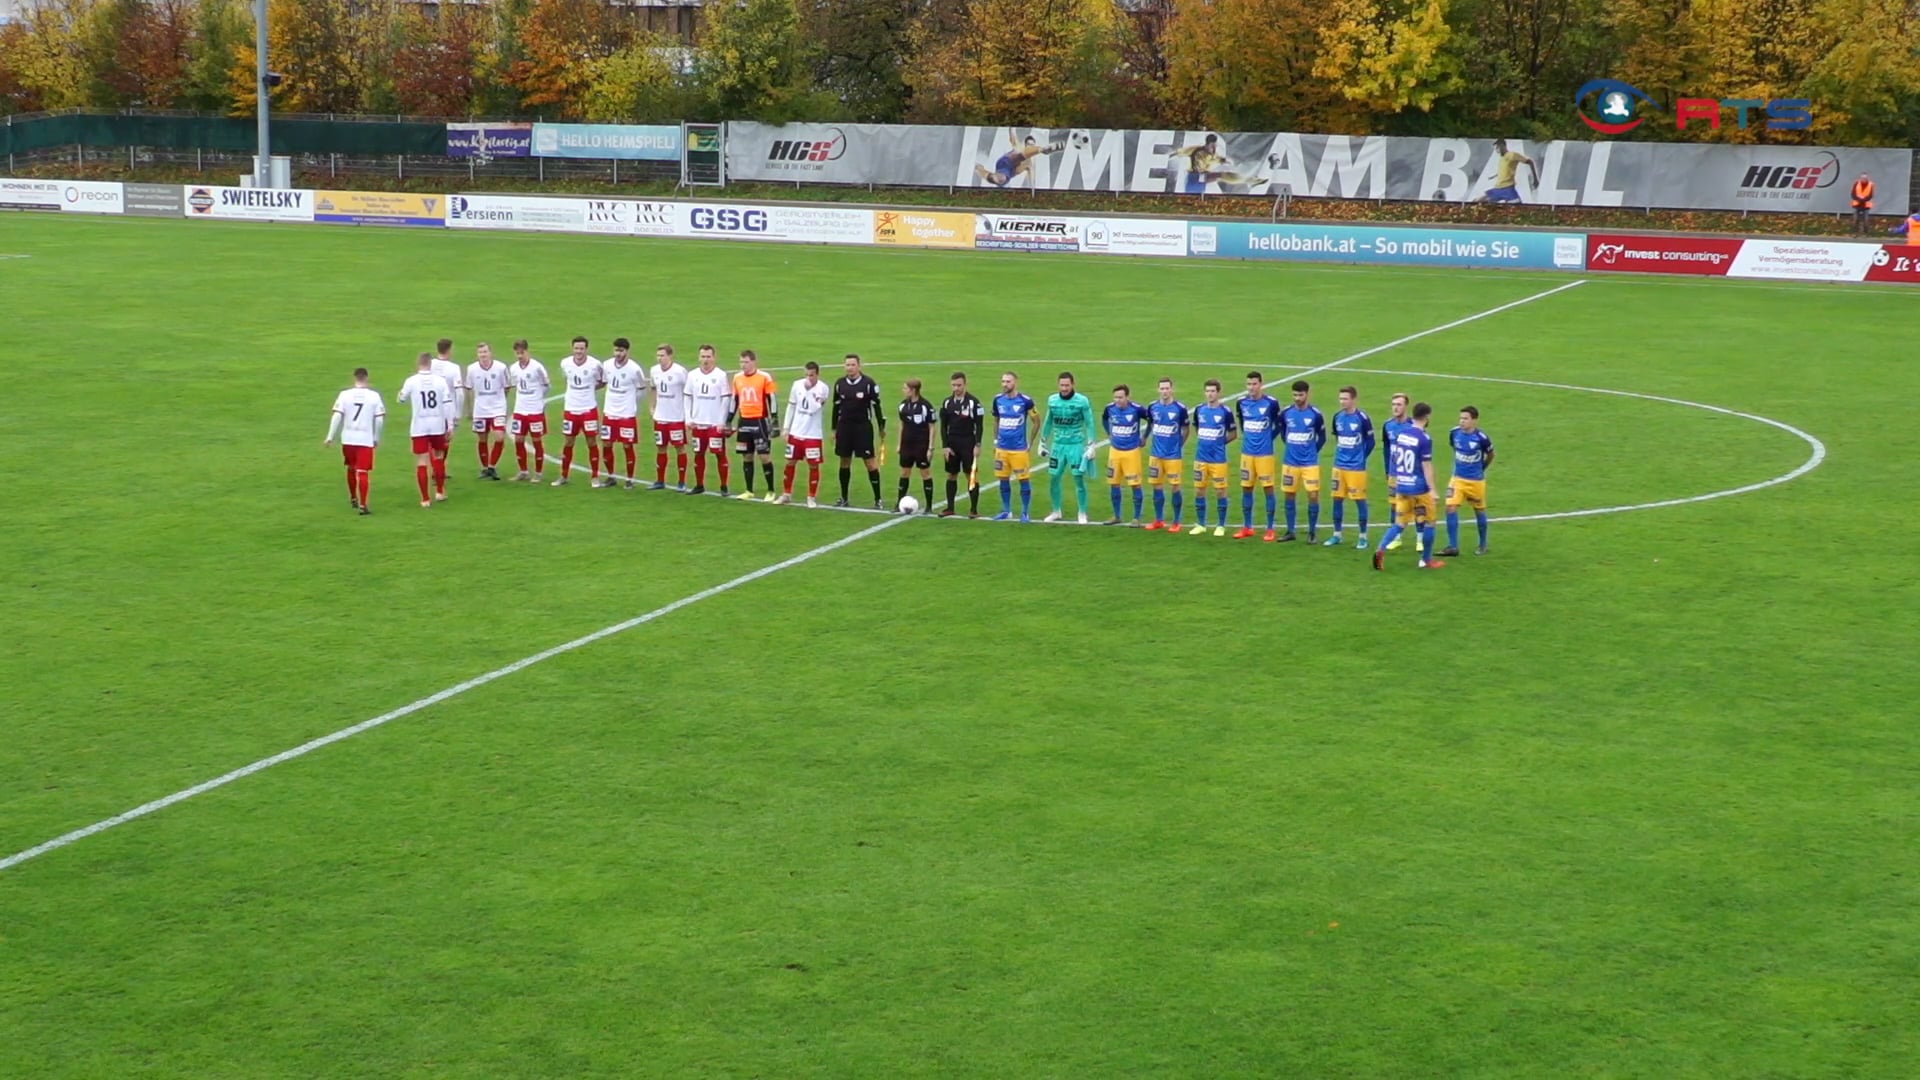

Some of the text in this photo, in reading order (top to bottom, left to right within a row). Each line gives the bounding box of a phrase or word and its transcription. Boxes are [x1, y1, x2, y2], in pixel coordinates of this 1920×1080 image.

[562, 135, 601, 147] HELLO
[768, 140, 832, 161] HGS
[1248, 133, 1387, 199] AM
[1418, 138, 1625, 206] BALL
[1741, 165, 1822, 189] HGS
[81, 190, 118, 201] recon
[222, 189, 302, 208] SWIETELSKY
[903, 216, 935, 227] Happy
[912, 228, 955, 238] together
[1248, 232, 1356, 254] hellobank.at
[1375, 236, 1398, 254] So
[1402, 239, 1453, 256] mobil
[1455, 240, 1487, 258] wie
[1491, 241, 1520, 259] Sie
[1773, 247, 1829, 255] Spezialisierte
[1624, 250, 1720, 264] invest consulting
[1758, 256, 1843, 266] Vermögensberatung
[420, 390, 437, 409] 18
[353, 403, 364, 421] 7
[1396, 447, 1416, 474] 20
